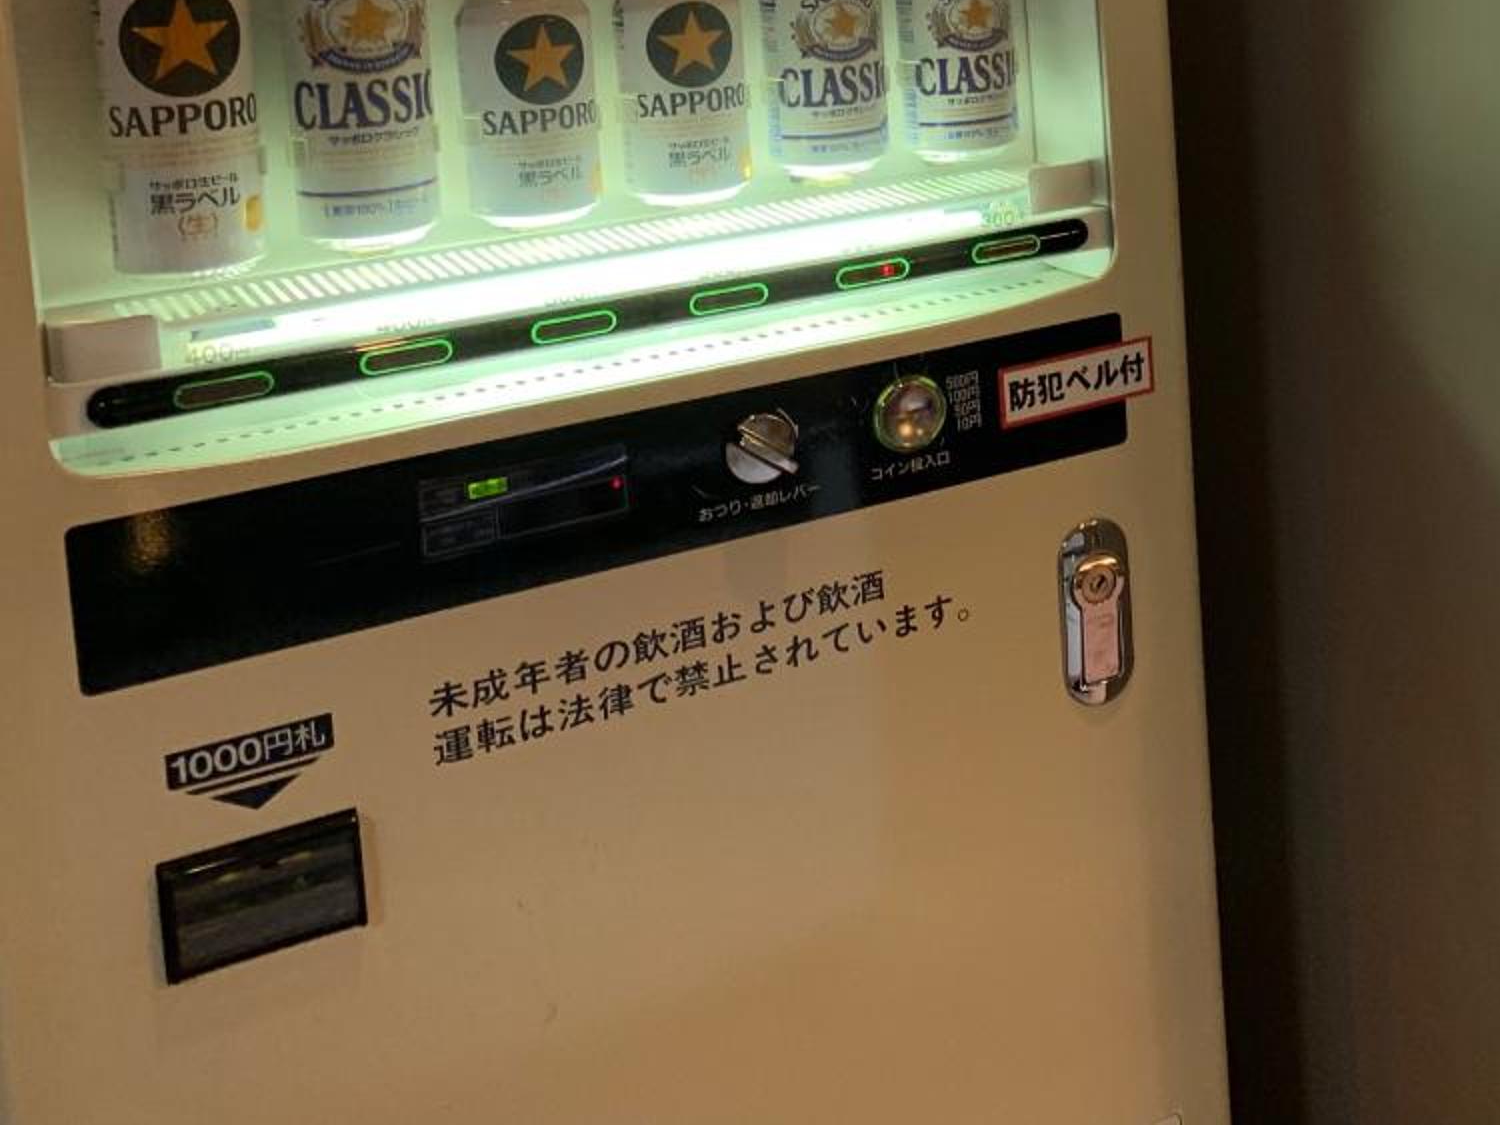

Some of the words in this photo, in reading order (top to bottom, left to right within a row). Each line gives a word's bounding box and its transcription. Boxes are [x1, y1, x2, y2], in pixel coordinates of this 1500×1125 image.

[150, 184, 241, 215] 黒ラベル
[948, 387, 980, 405] 100円
[1008, 352, 1145, 411] 防犯ベル付
[955, 401, 981, 417] 50円
[957, 415, 982, 430] 10円
[872, 452, 951, 481] コイン投入口
[428, 570, 886, 718] 未成年者の飲酒および飲酒
[433, 594, 972, 768] 運転は法律で禁止されています。
[169, 722, 326, 786] 1000円札
